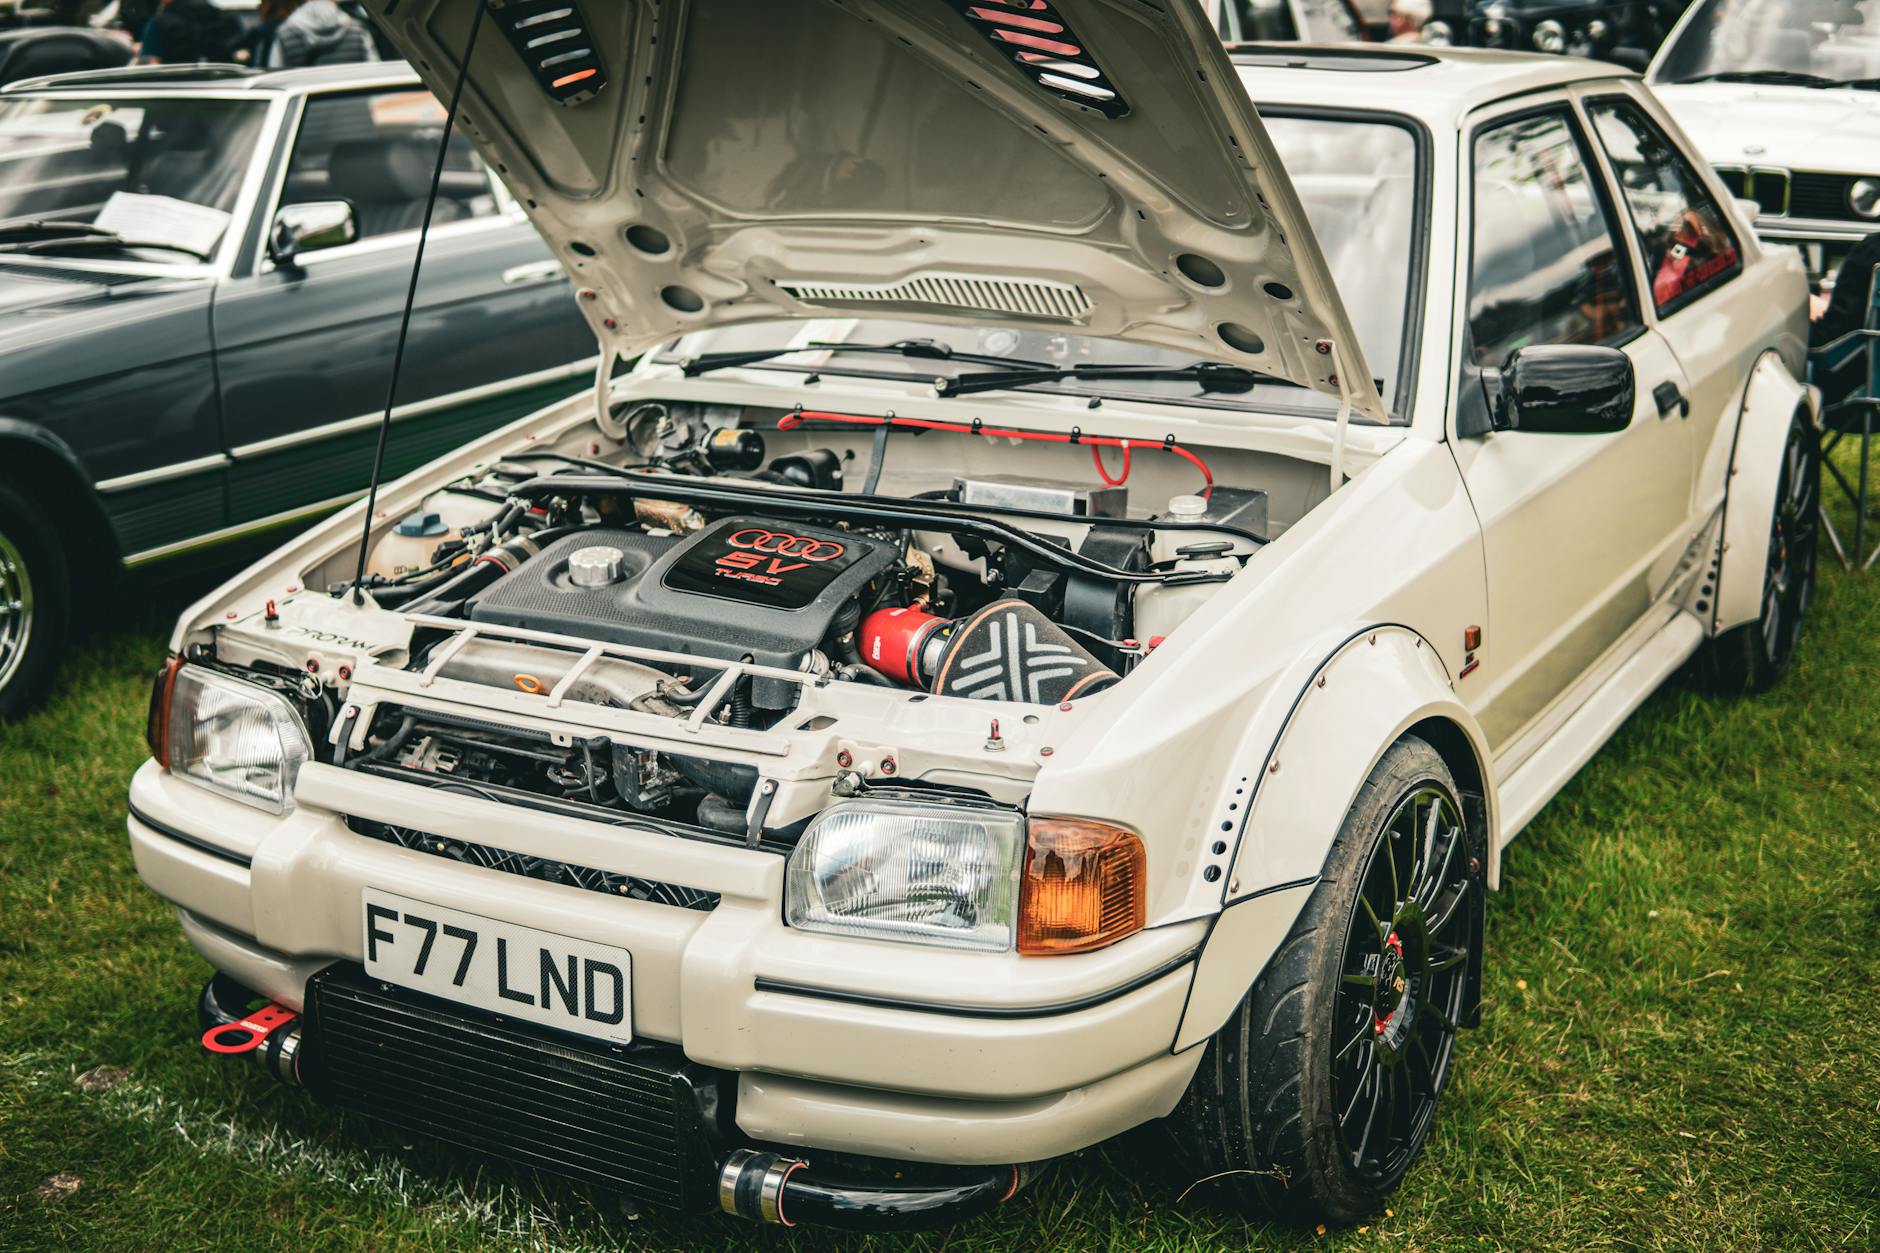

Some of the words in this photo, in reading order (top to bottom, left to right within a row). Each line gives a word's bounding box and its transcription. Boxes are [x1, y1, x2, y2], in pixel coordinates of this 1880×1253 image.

[715, 568, 783, 586] TURBO
[367, 902, 478, 987] F77
[497, 937, 624, 1025] LND
